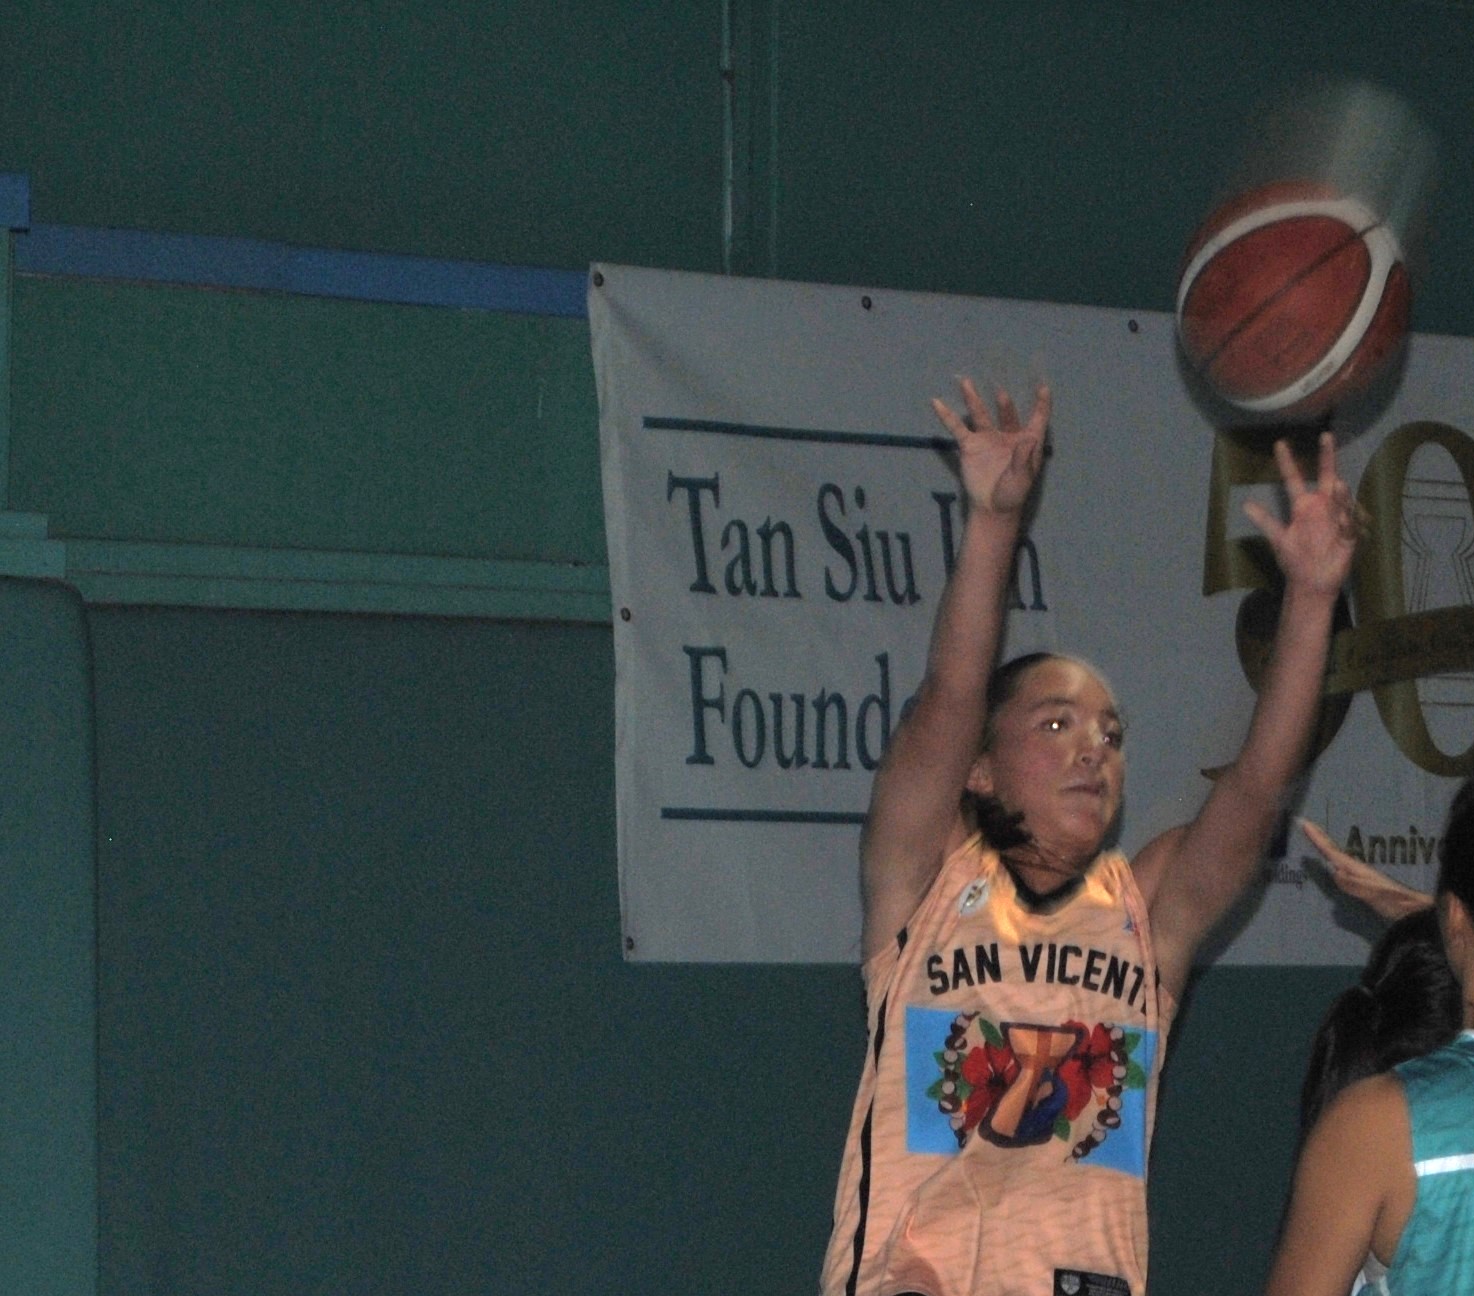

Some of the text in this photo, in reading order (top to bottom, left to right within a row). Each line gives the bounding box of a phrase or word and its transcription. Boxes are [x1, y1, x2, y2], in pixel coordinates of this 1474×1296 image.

[667, 469, 802, 597] Tan
[817, 483, 921, 605] Siu
[682, 645, 914, 771] Found
[1345, 825, 1441, 866] Anniv
[926, 943, 1147, 1014] SAN VICENT
